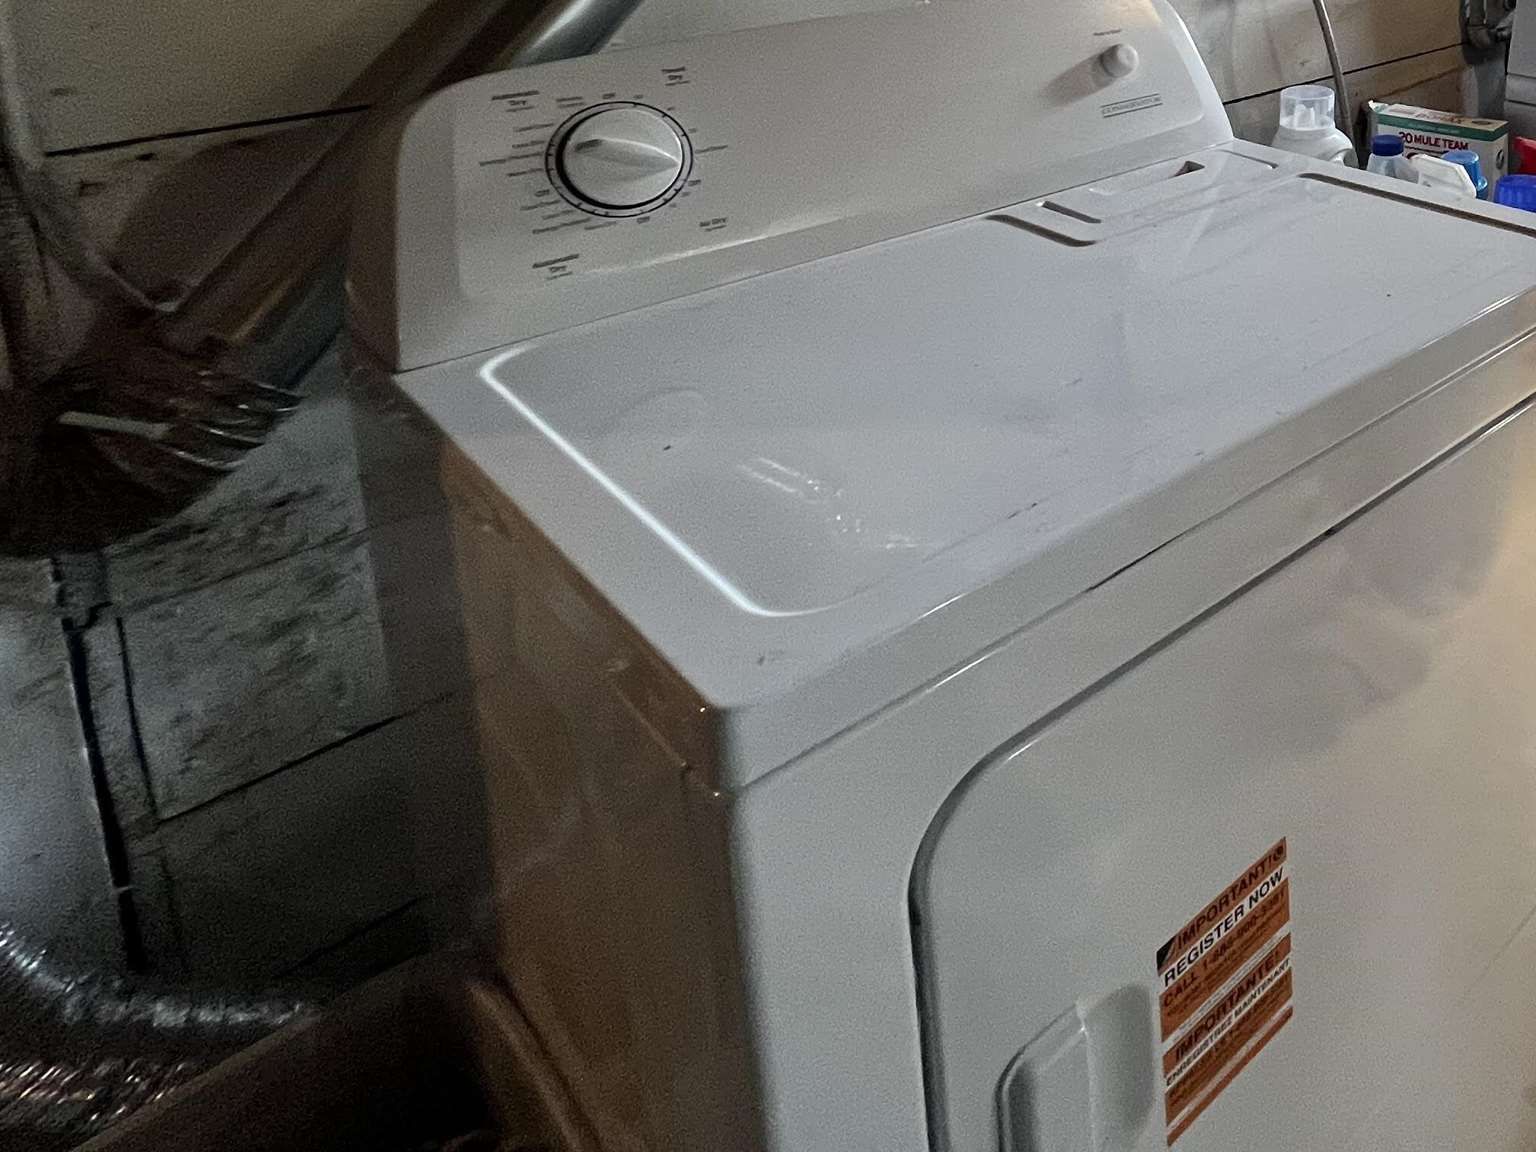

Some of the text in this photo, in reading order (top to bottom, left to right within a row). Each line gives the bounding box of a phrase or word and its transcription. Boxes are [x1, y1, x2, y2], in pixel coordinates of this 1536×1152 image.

[1414, 134, 1441, 148] MULE
[1442, 138, 1469, 151] TEAM
[1163, 904, 1245, 988] REGISTER
[1247, 866, 1284, 910] NOW
[1177, 854, 1272, 951] IMPORTANT!
